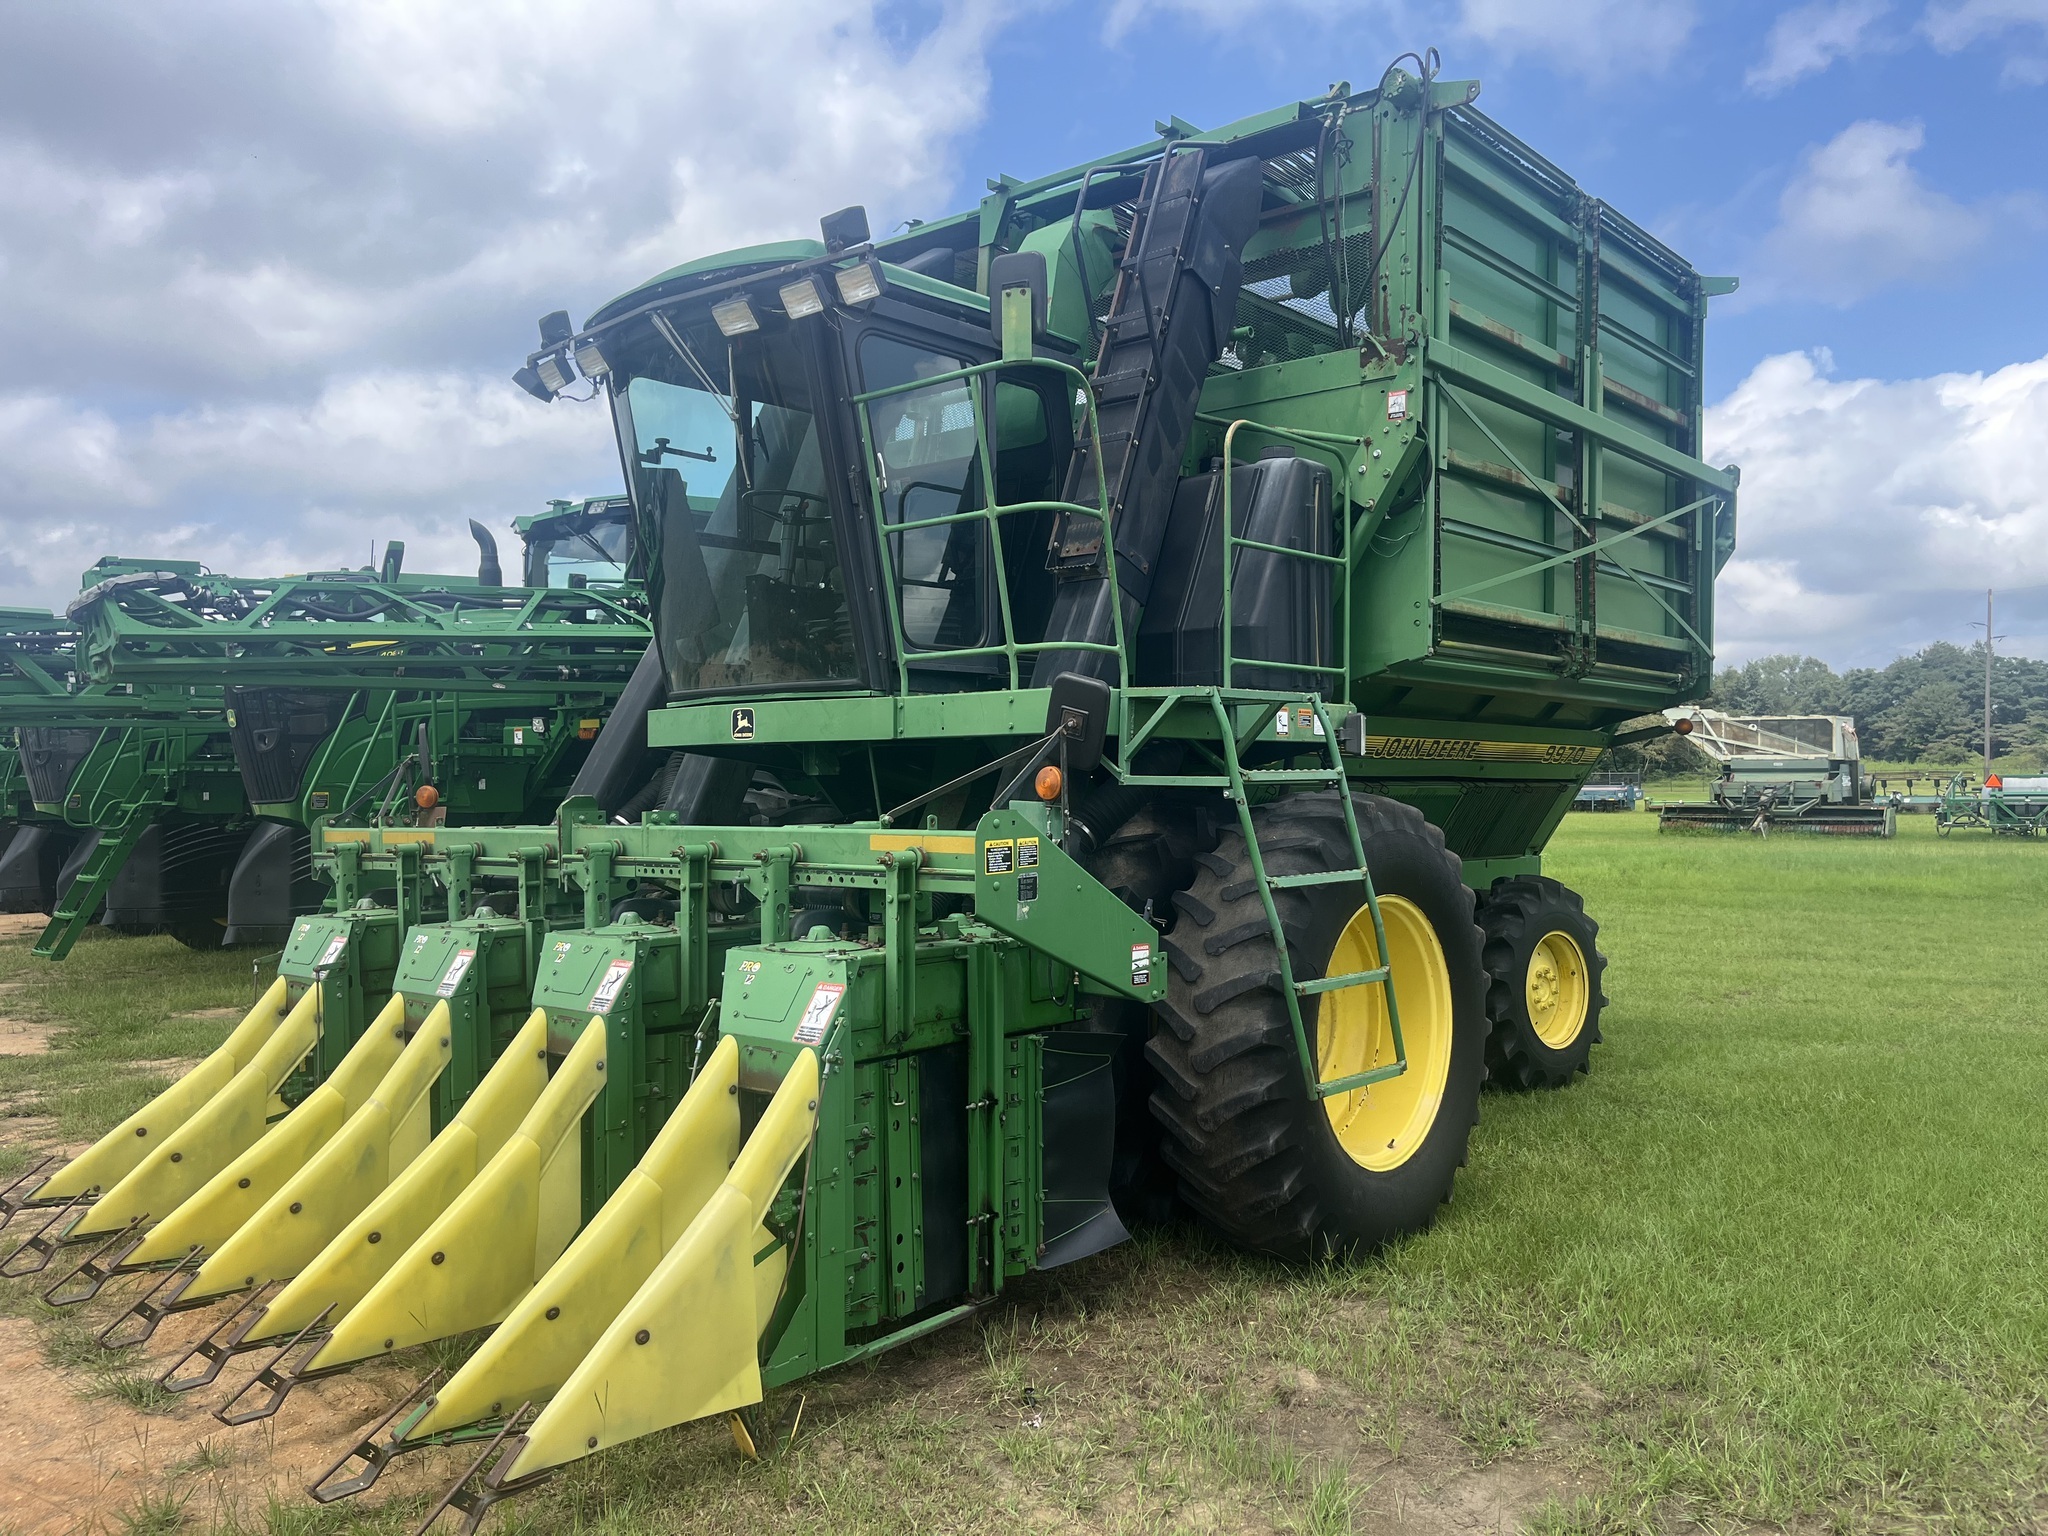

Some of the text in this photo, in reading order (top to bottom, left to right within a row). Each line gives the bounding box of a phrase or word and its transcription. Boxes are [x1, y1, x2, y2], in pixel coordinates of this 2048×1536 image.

[1373, 737, 1481, 761] JOHN DEERE
[1541, 744, 1587, 765] 9970
[553, 941, 571, 952] PRO
[739, 960, 761, 972] PRO
[744, 974, 756, 985] 12
